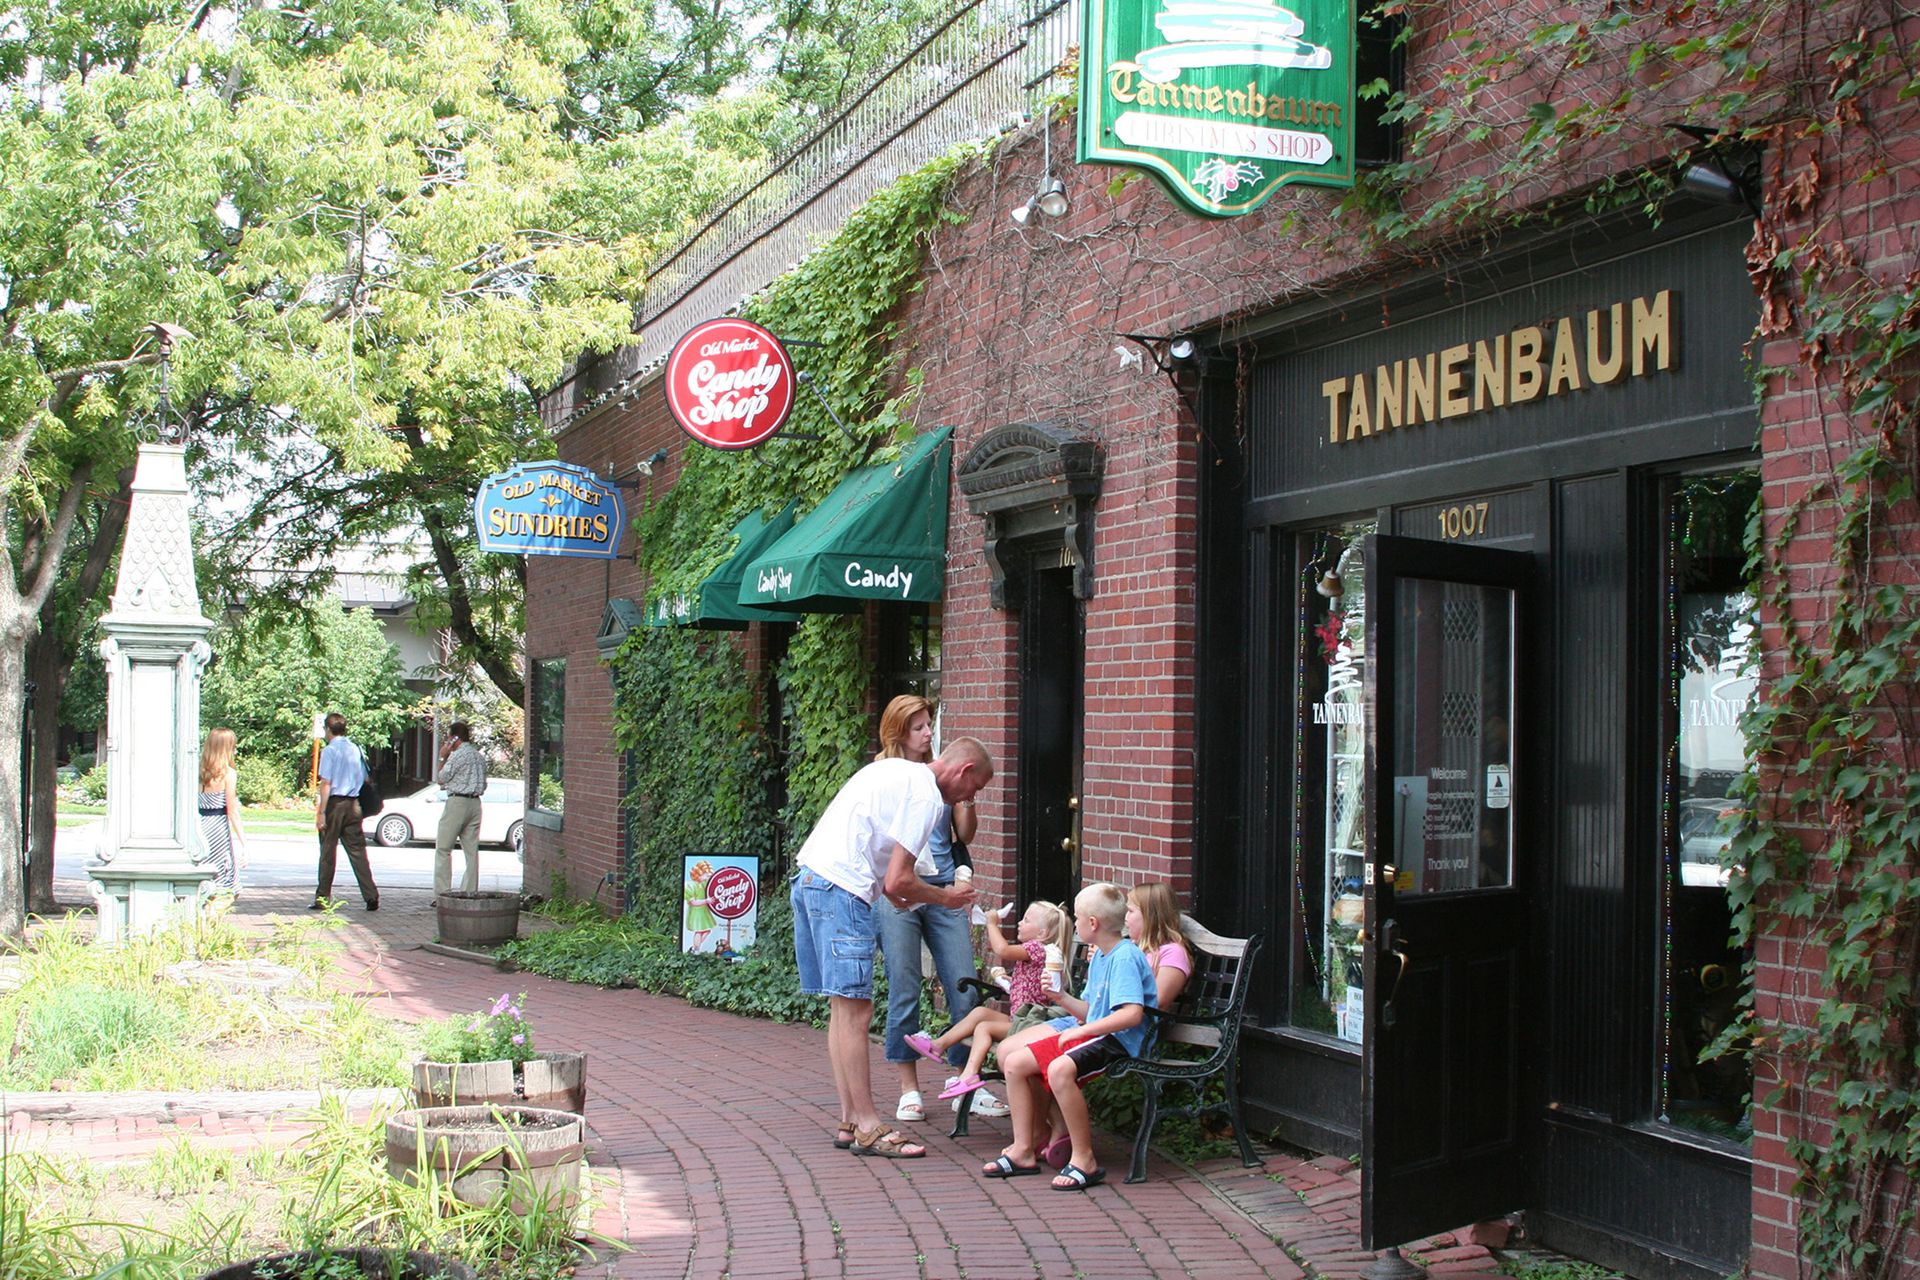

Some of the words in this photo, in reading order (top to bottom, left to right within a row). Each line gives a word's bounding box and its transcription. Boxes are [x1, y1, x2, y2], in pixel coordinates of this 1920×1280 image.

[1107, 60, 1342, 128] Tannenbaum
[1267, 133, 1322, 160] SHOP
[700, 340, 720, 357] Old
[722, 338, 760, 353] Market
[687, 353, 782, 396] Candy
[1322, 289, 1676, 443] TANNENBAUM
[689, 390, 769, 428] Shop
[502, 480, 535, 500] OLD
[537, 473, 602, 507] MARKET
[488, 507, 609, 542] SUNDRIES
[1438, 502, 1489, 539] 1007
[844, 562, 913, 598] Candy
[1431, 767, 1468, 780] Welcome
[1428, 858, 1451, 871] Thank
[1453, 856, 1469, 871] you!
[714, 878, 750, 899] Candy
[715, 893, 746, 911] Shop
